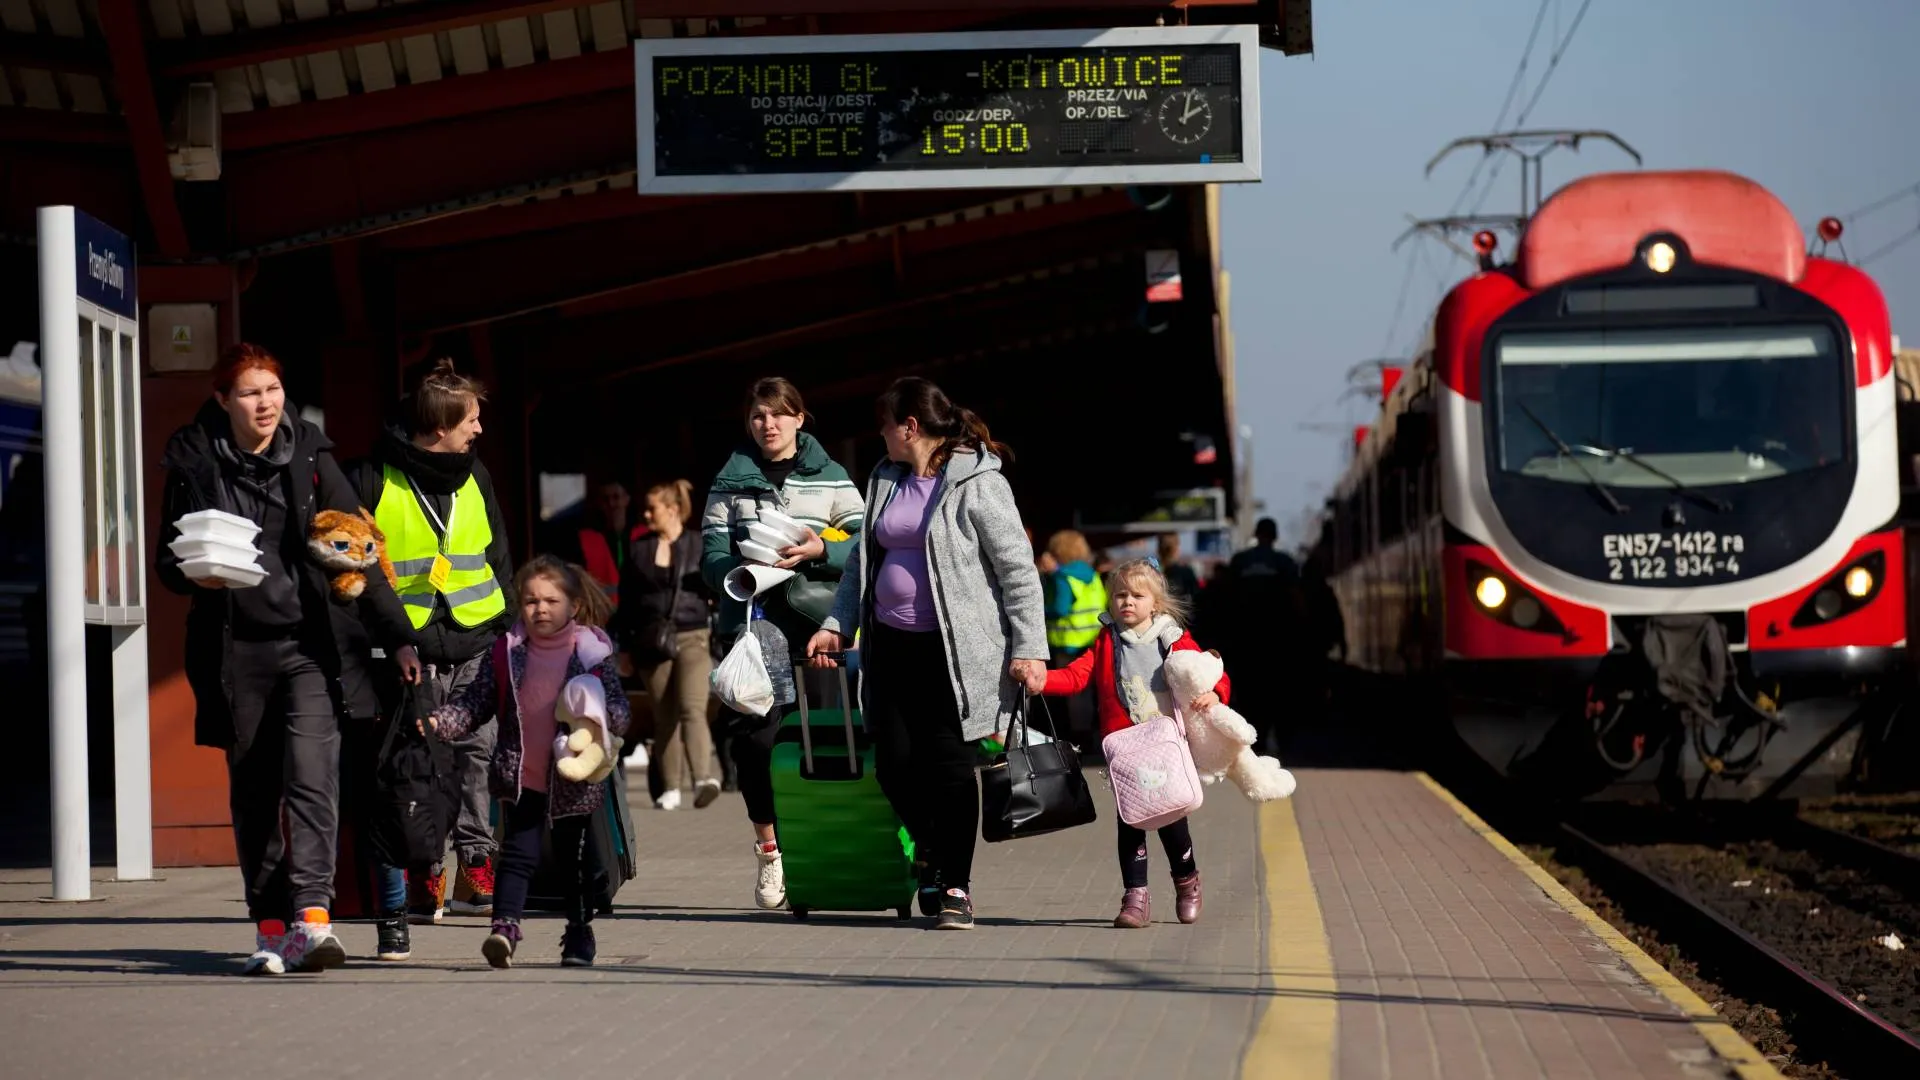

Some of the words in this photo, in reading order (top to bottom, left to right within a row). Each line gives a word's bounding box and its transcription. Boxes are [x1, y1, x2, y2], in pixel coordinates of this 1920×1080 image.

[751, 96, 773, 109] DO
[1067, 89, 1148, 102] PRZEZ/VIA
[932, 108, 1016, 123] GODZ/DEP.
[765, 127, 864, 157] SPEC
[921, 122, 1029, 154] 15:00
[1602, 531, 1717, 558] EN57-1412
[1608, 558, 1624, 580] 2
[1630, 556, 1668, 579] 122
[1674, 554, 1740, 577] 934-4
